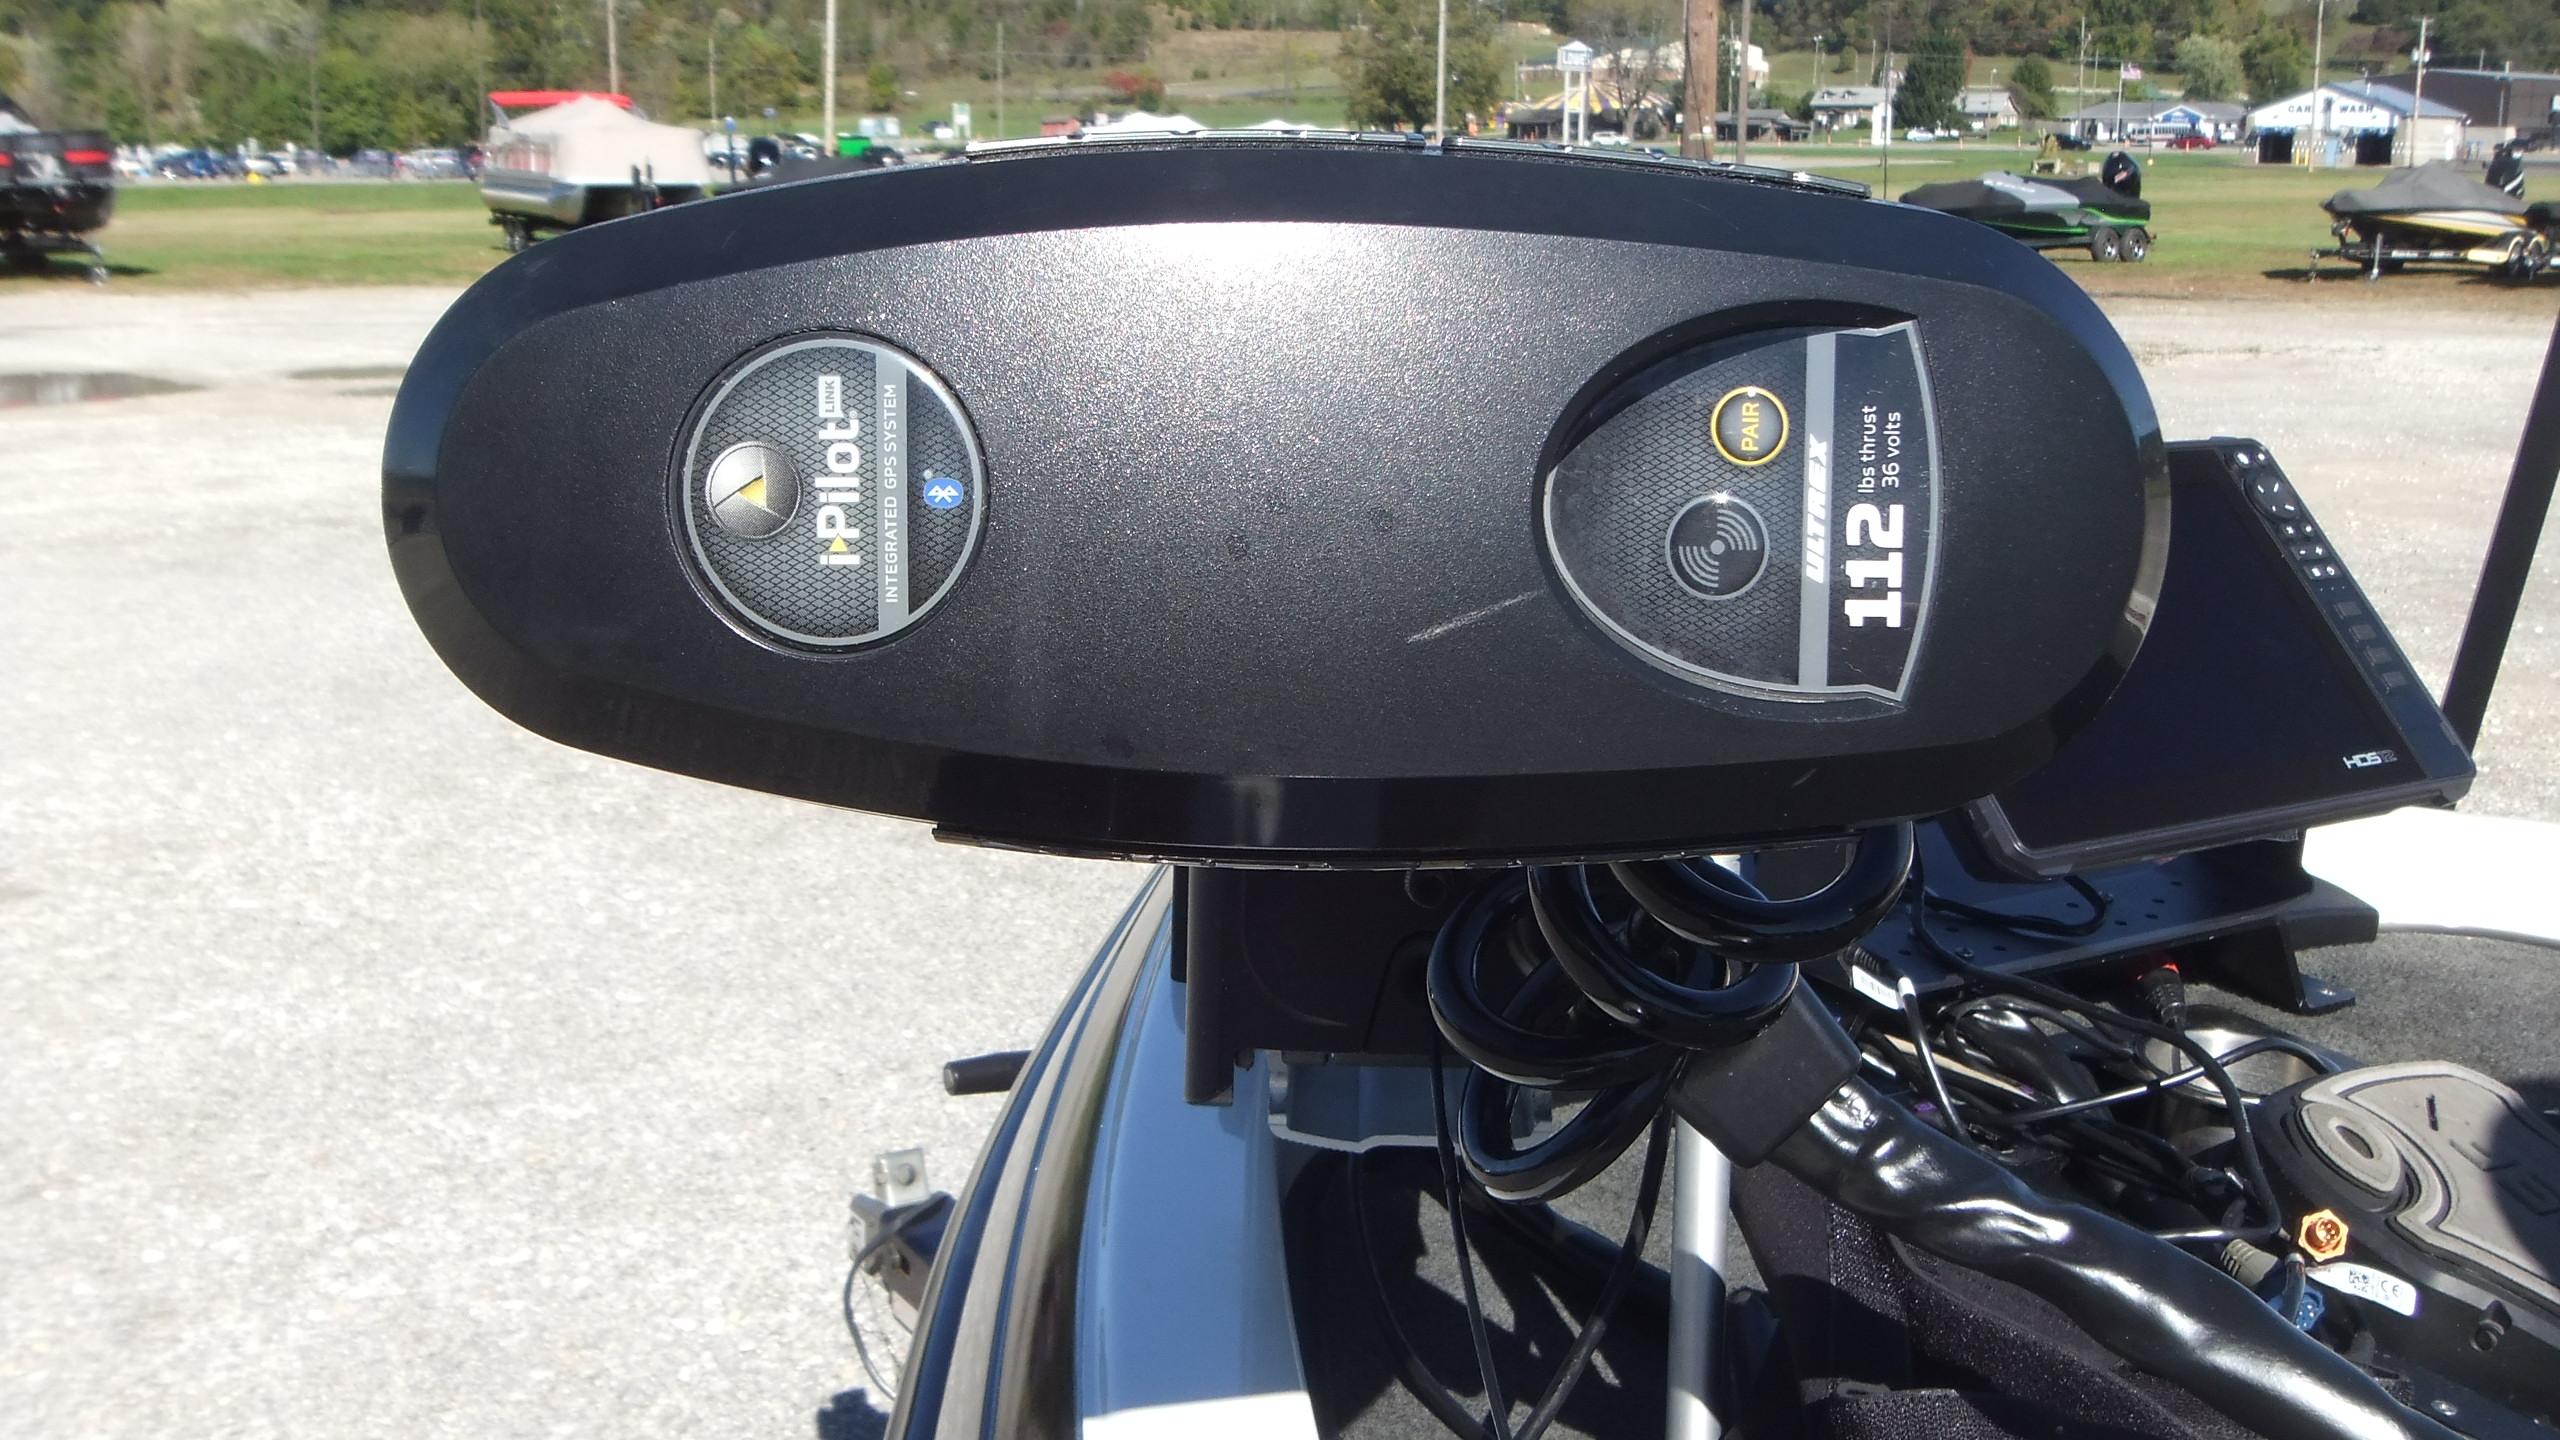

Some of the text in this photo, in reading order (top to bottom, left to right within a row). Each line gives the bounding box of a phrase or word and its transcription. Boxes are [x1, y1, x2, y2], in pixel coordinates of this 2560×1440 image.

[2288, 104, 2374, 113] CAR WASH
[824, 379, 835, 413] LINK
[1741, 402, 1760, 452] PAIR
[1857, 405, 1877, 494] lbs thrust
[1881, 412, 1901, 488] 36 volts
[882, 384, 898, 603] INTEGRATED GPS SYSTEM
[1806, 433, 1828, 584] ULTREX
[1844, 503, 1904, 628] 112
